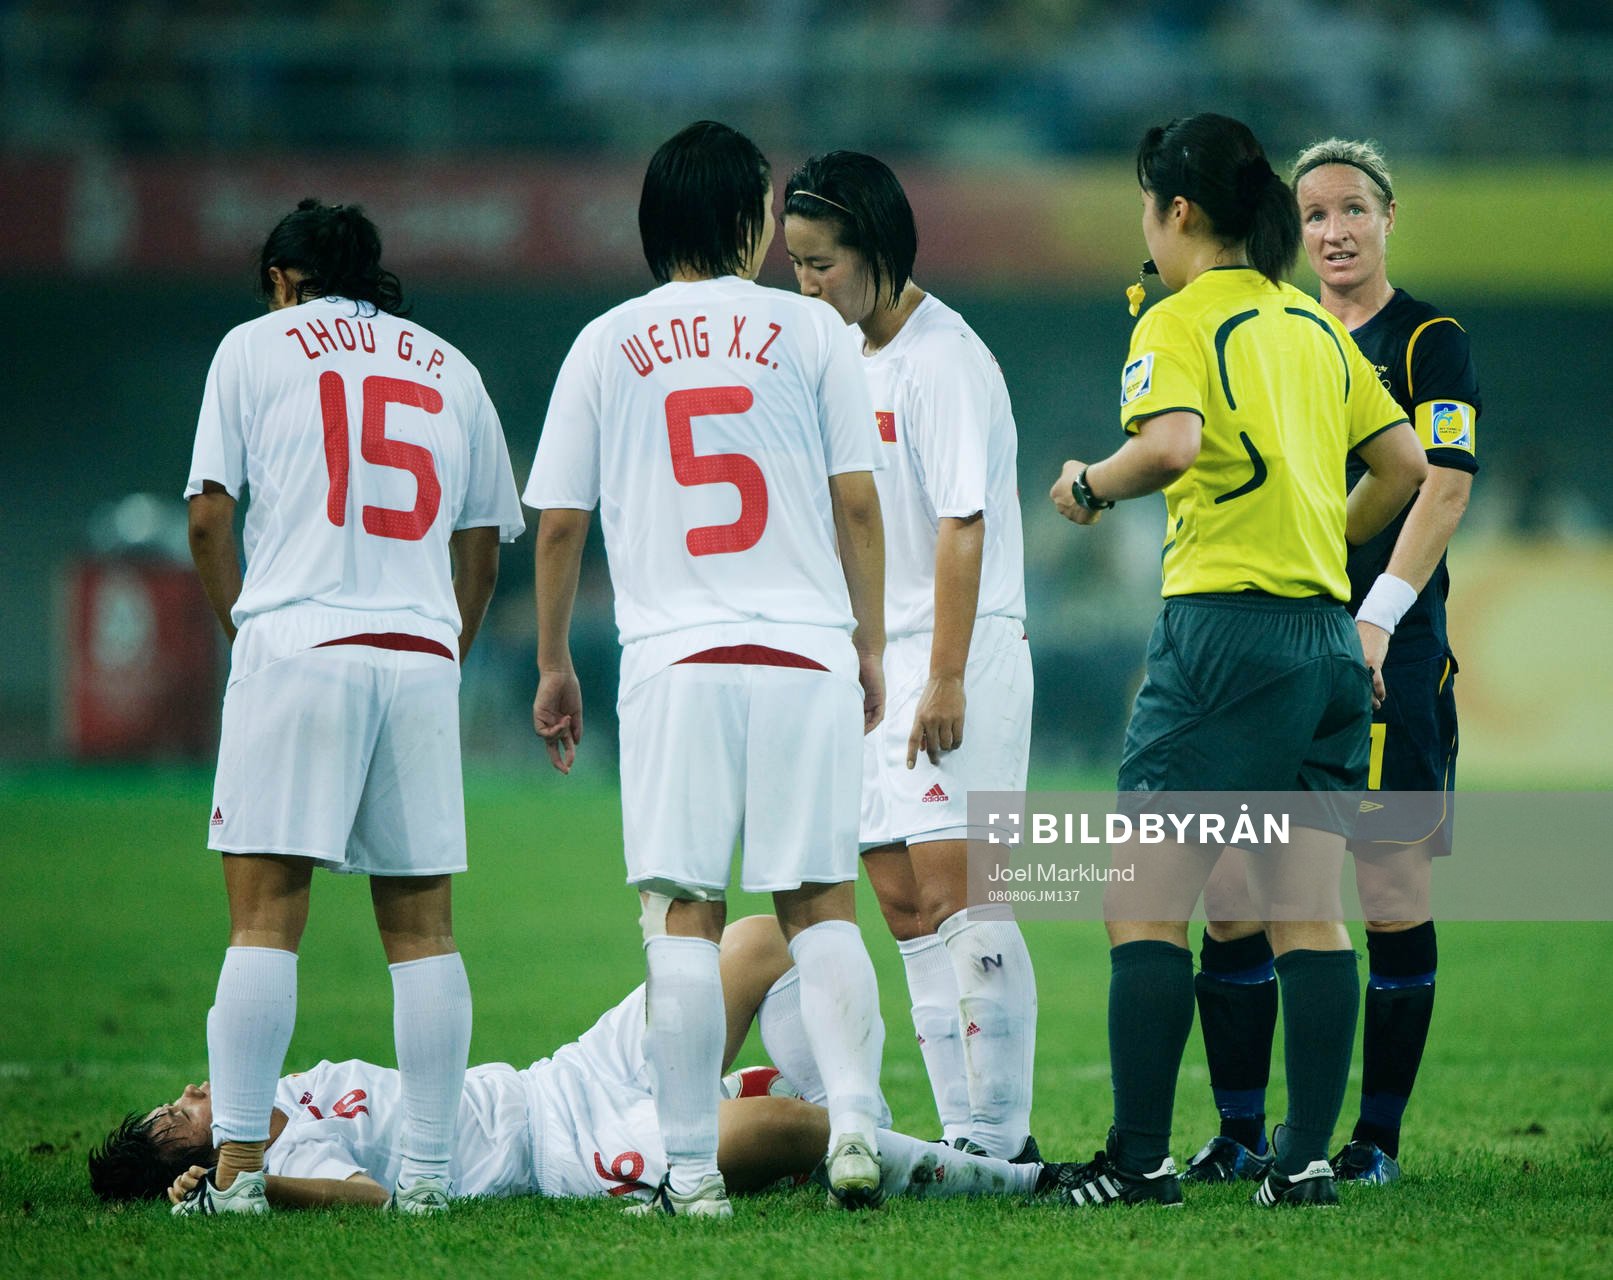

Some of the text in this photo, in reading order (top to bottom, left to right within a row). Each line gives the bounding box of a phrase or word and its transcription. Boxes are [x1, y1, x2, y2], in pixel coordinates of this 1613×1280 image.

[286, 318, 445, 379] ZHOU G.P.
[621, 315, 782, 377] WENG X.Z.
[319, 370, 444, 541] 15
[664, 385, 769, 558] 5
[921, 793, 949, 803] adidas
